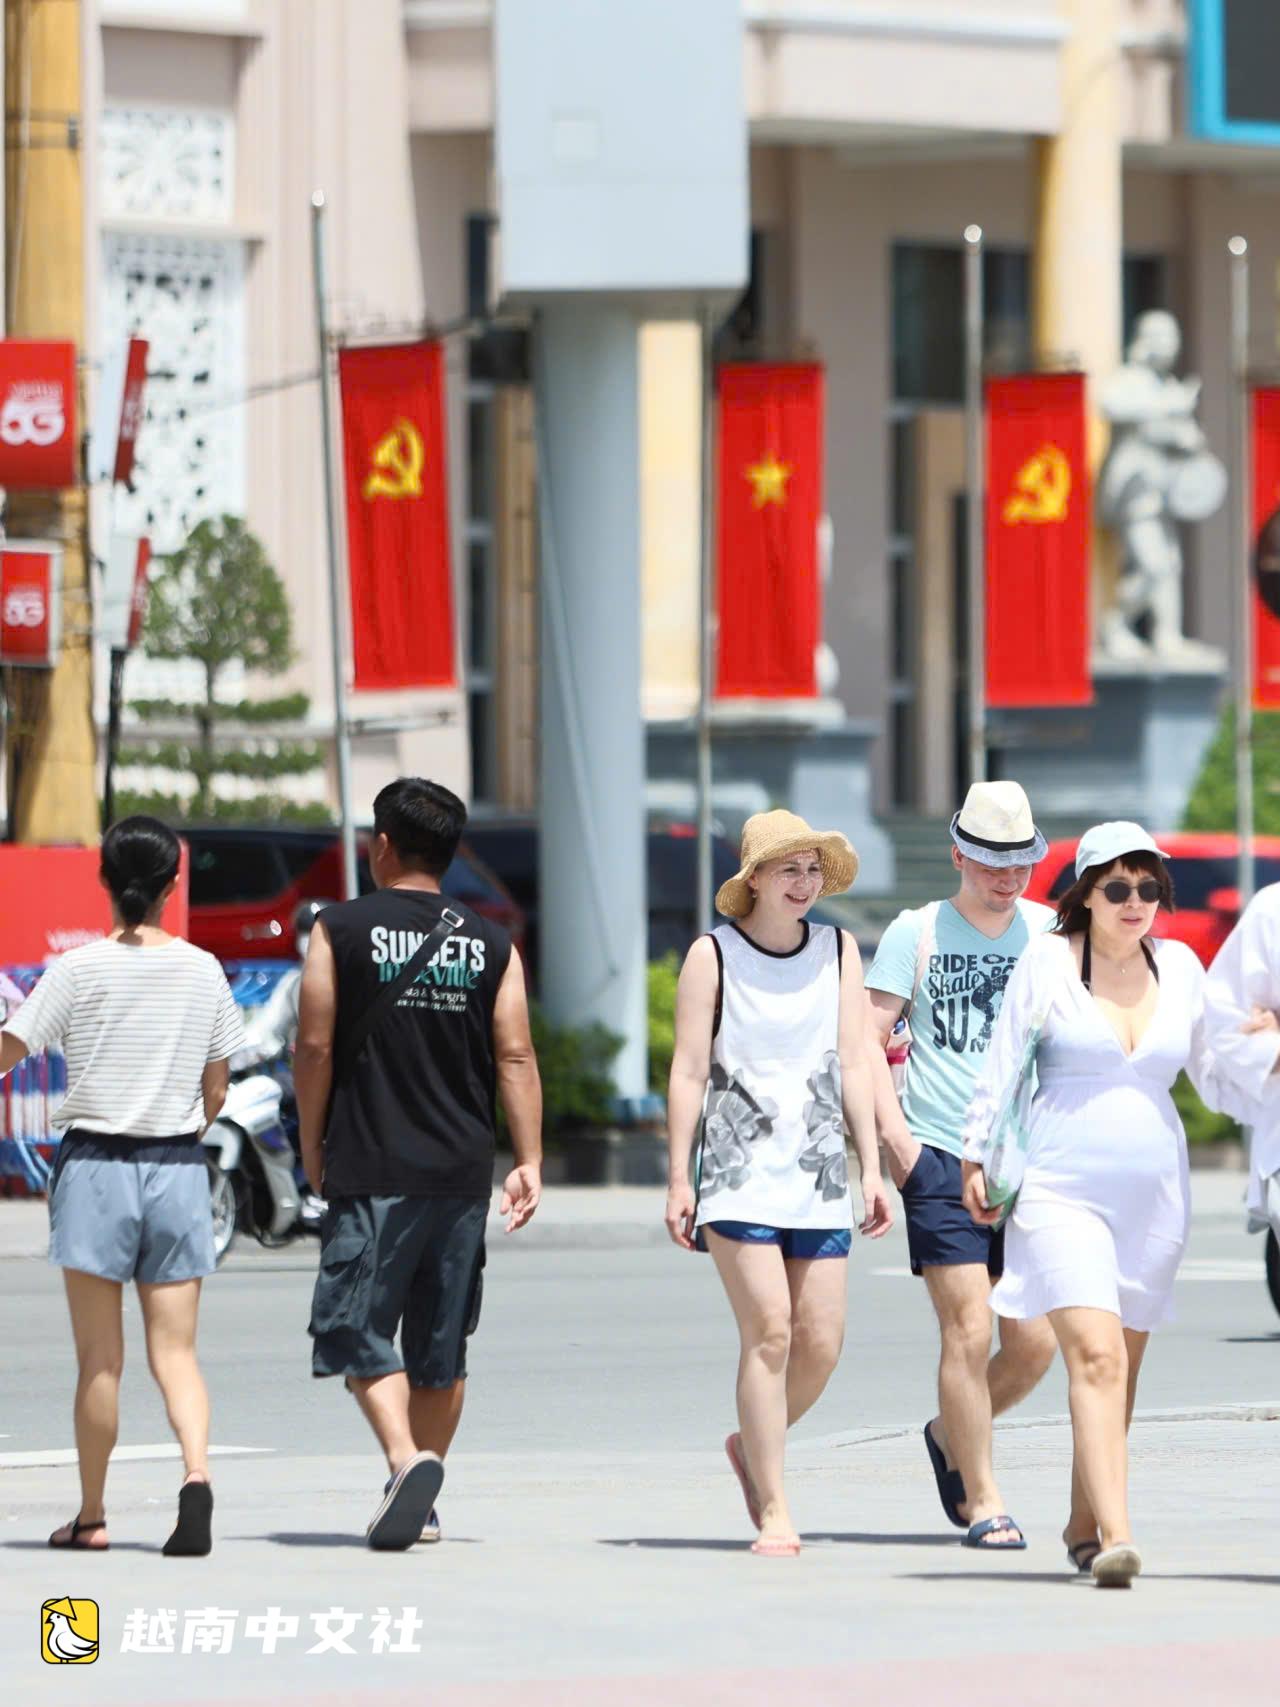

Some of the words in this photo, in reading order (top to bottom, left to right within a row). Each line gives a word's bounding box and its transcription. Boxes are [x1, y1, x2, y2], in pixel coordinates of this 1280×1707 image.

[929, 954, 978, 974] RIDE
[928, 971, 982, 1000] Skate
[931, 995, 971, 1054] SU
